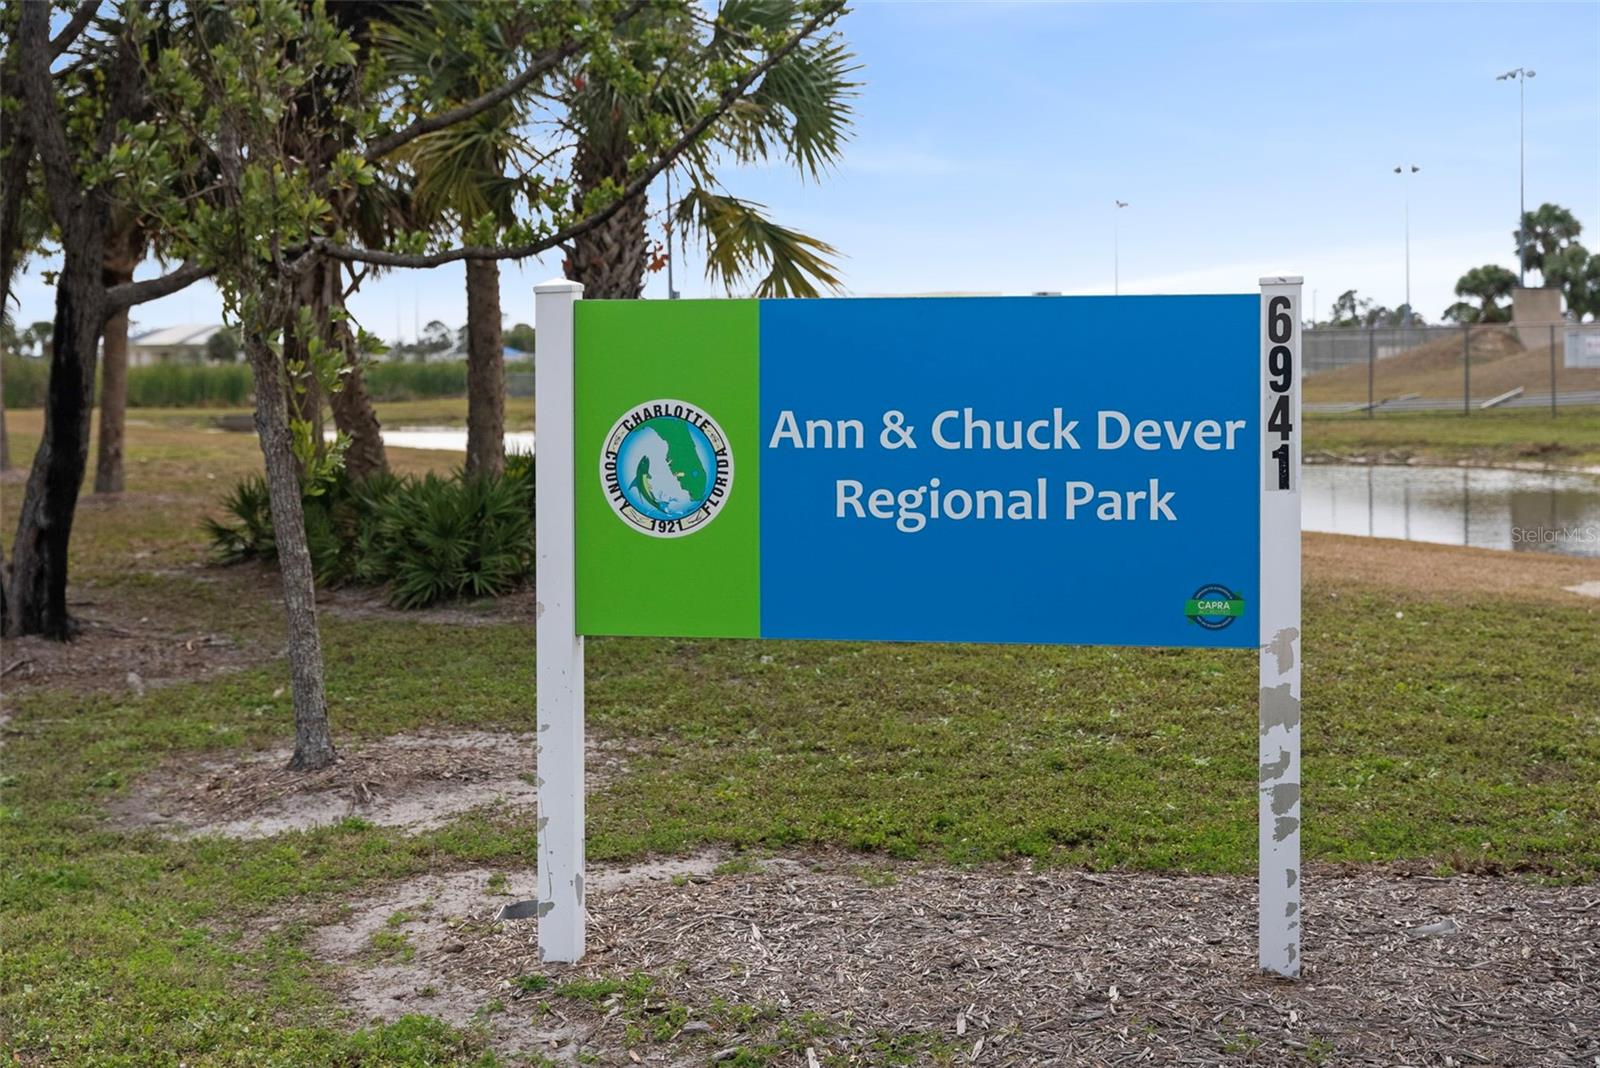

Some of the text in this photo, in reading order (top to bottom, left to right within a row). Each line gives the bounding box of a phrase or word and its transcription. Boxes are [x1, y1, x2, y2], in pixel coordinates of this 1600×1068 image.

[1267, 295, 1293, 490] 6941
[623, 404, 711, 432] CHARLOTTE
[769, 408, 1246, 451] Ann & Chuck Dever
[604, 450, 630, 511] COUNTY
[701, 447, 729, 516] FLORIDA
[650, 520, 684, 533] 1921
[836, 478, 1177, 533] Regional Park
[1197, 601, 1231, 610] CAPRA
